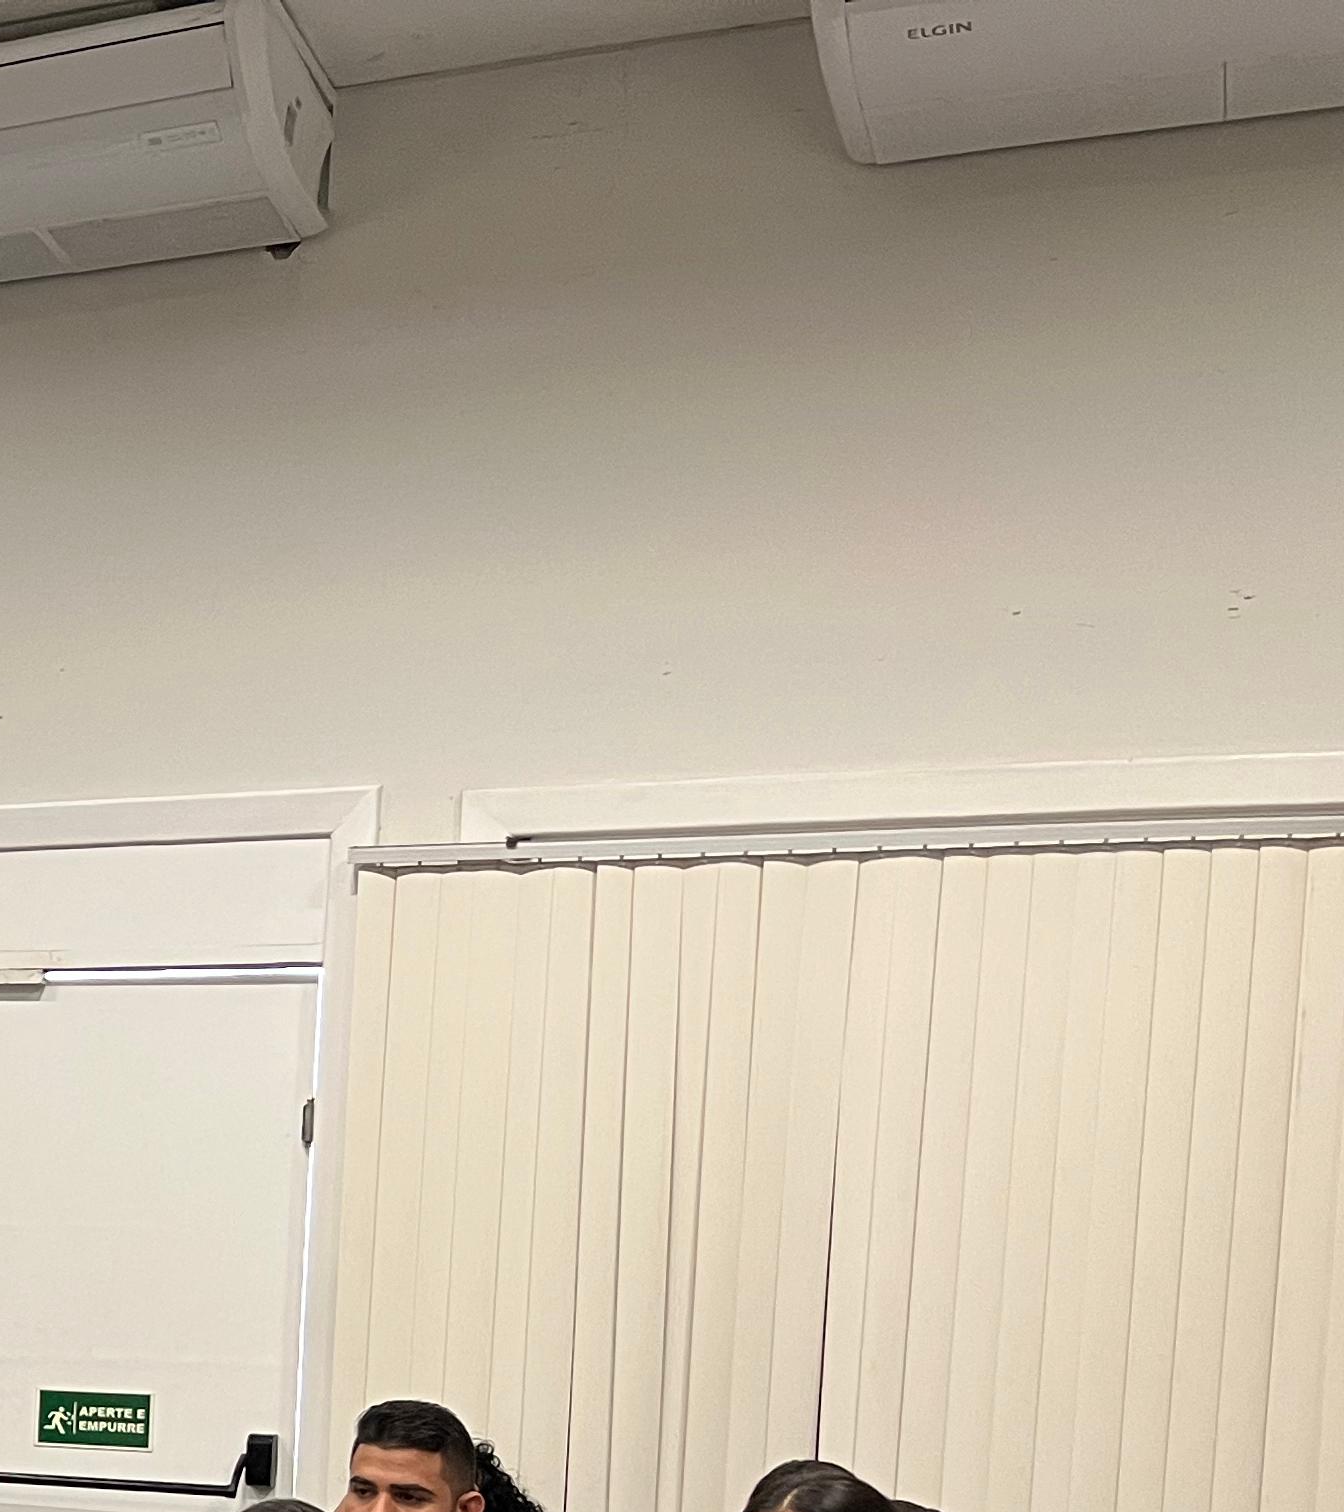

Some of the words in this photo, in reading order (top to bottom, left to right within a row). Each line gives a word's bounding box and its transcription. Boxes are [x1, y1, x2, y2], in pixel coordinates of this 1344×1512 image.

[907, 21, 972, 39] ELGIN
[78, 1406, 133, 1419] APERTE
[136, 1408, 146, 1420] E
[78, 1421, 145, 1434] EMPURRE
